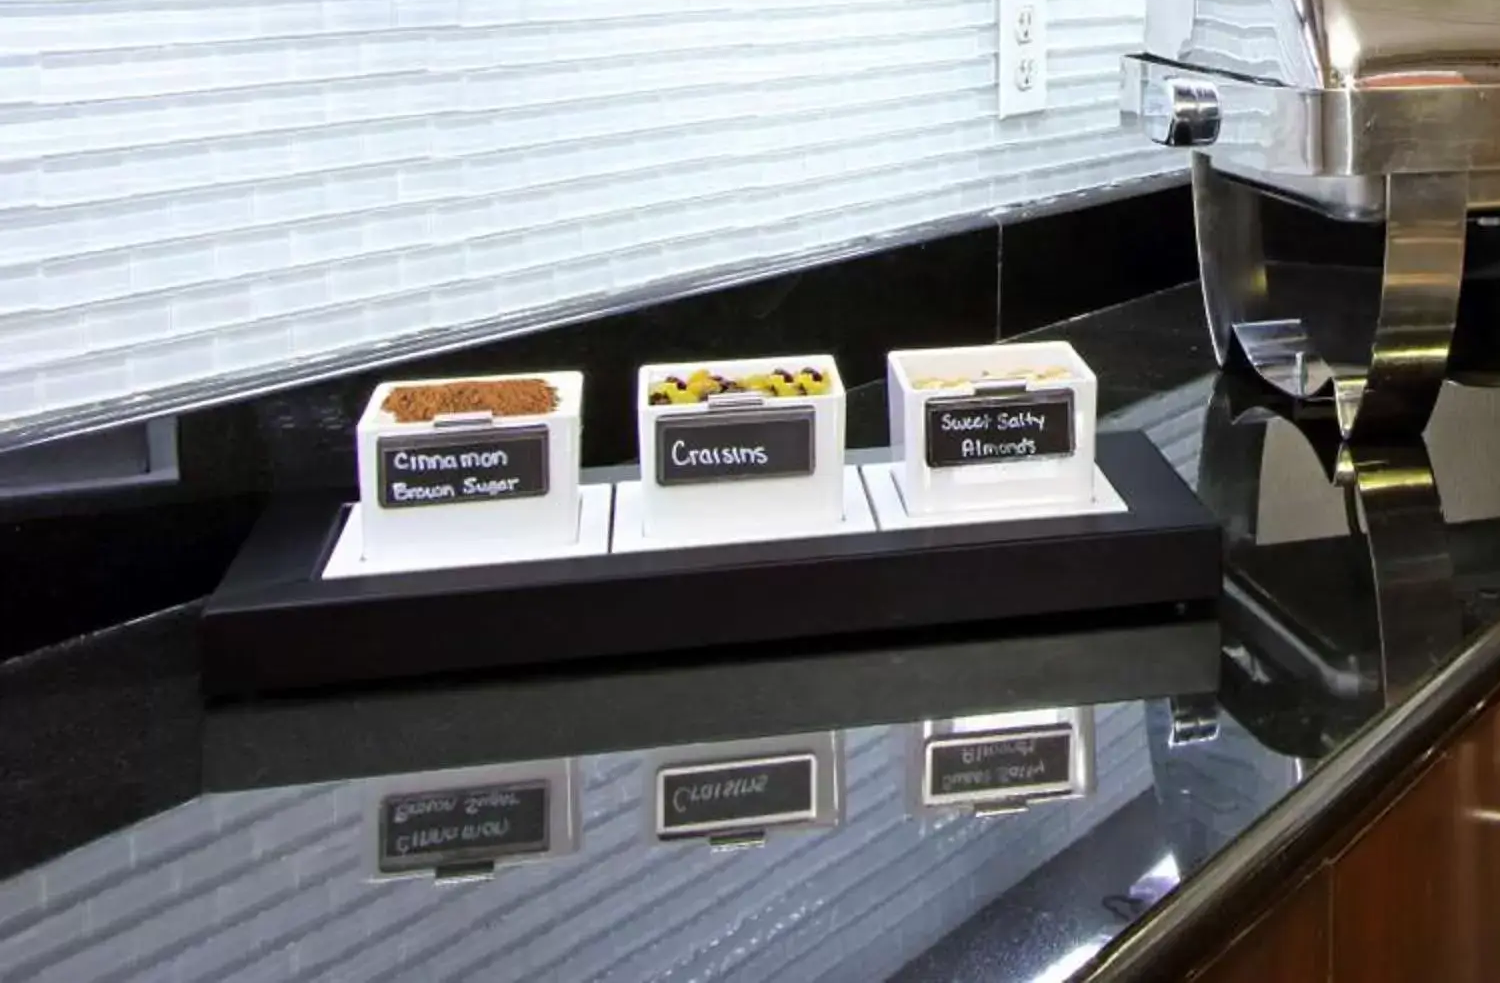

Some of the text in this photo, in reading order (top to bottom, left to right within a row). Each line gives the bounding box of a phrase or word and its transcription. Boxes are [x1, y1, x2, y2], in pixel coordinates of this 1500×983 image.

[941, 411, 1046, 430] Sweet Salty
[671, 439, 769, 466] Craisins
[961, 436, 1037, 457] Almonds
[393, 449, 509, 471] Cinnamon
[392, 476, 520, 501] Brown Sugar
